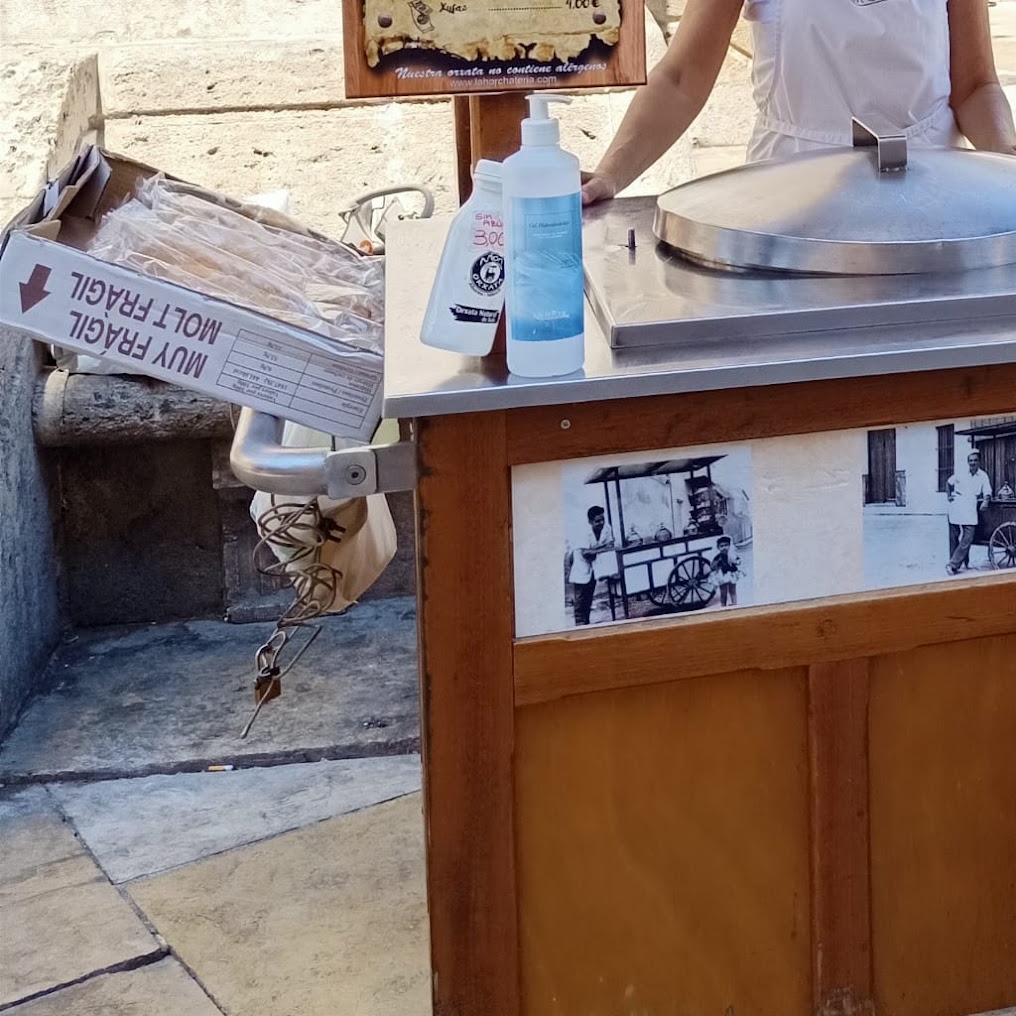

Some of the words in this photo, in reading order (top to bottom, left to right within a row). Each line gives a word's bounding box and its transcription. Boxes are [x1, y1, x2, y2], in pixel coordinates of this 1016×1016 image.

[395, 66, 442, 80] Nuestra
[488, 65, 502, 76] no
[506, 63, 552, 76] contiene
[69, 271, 154, 324] FRÀGIL
[68, 309, 152, 361] FRÁGIL
[154, 303, 224, 345] MOLT
[151, 341, 209, 380] MUY
